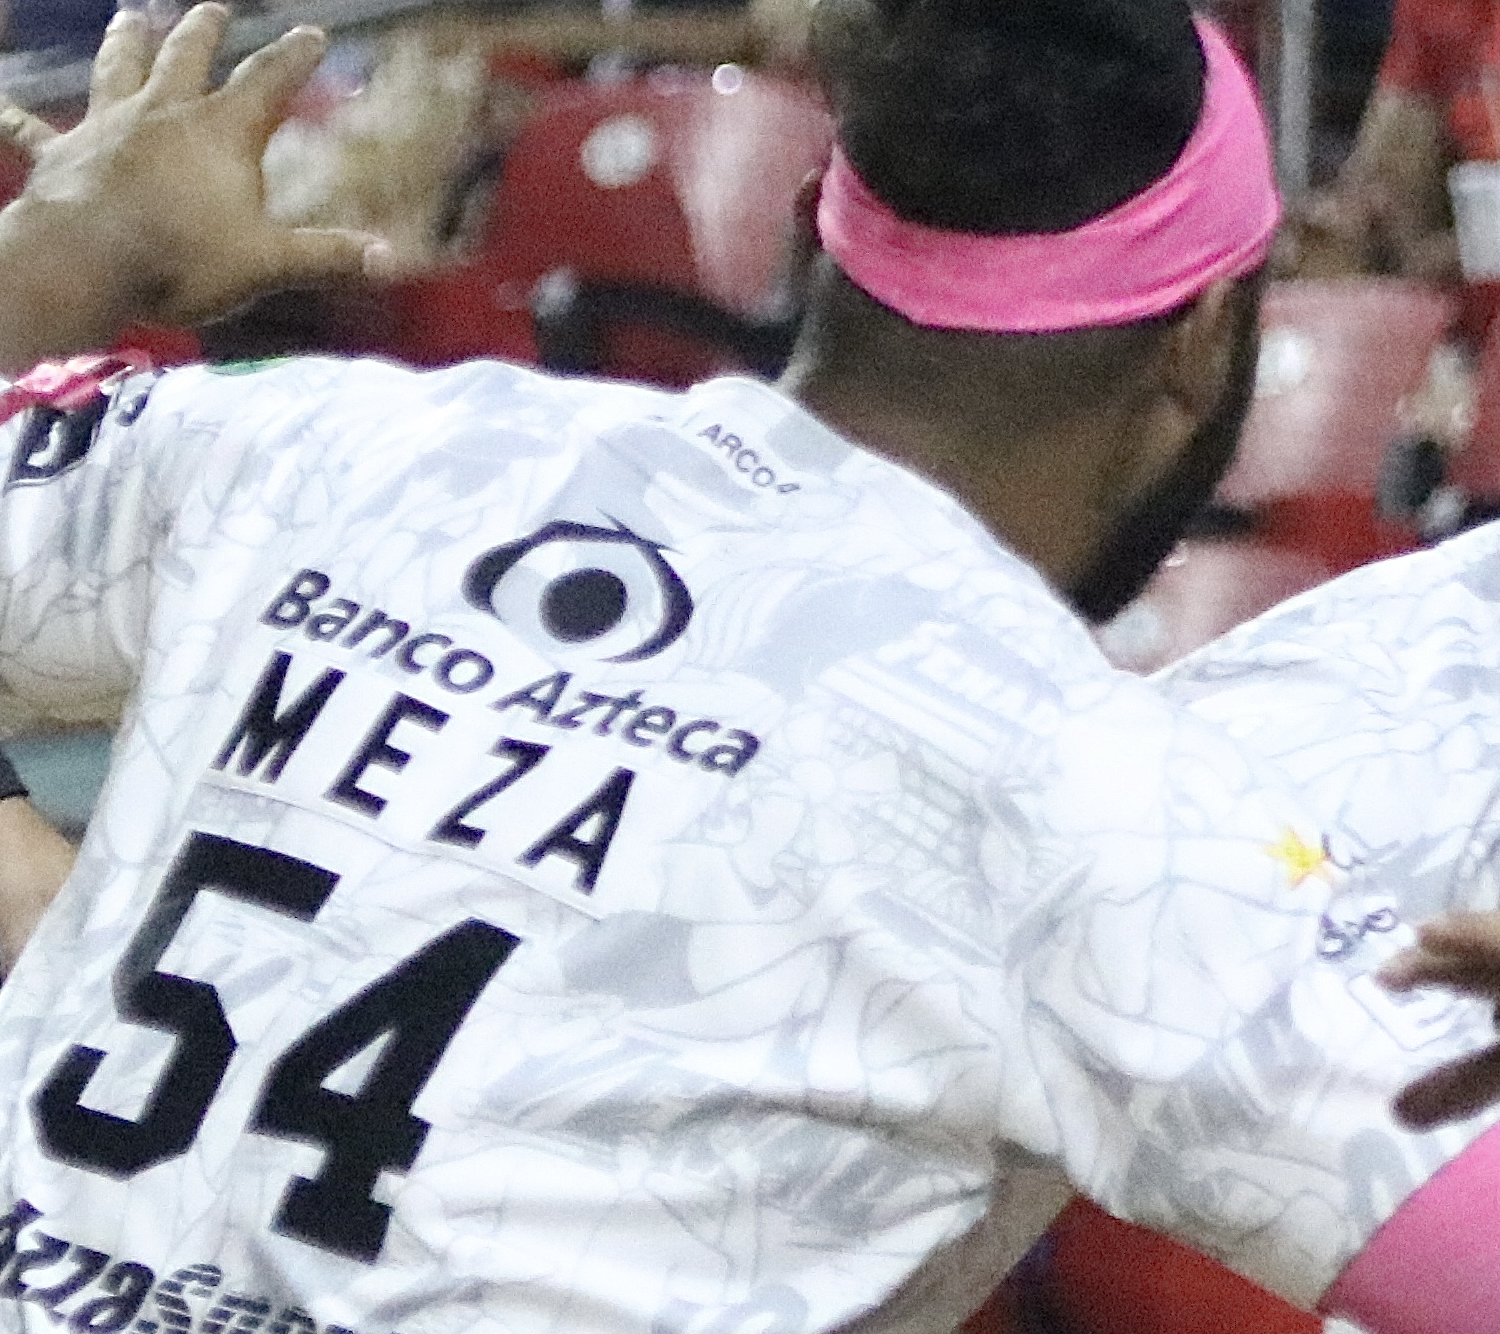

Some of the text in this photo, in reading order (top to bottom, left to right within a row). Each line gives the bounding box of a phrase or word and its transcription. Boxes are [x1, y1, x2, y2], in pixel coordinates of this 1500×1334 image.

[213, 647, 637, 897] MEZA
[259, 568, 762, 779] Banco Azteca
[27, 829, 523, 1265] 54
